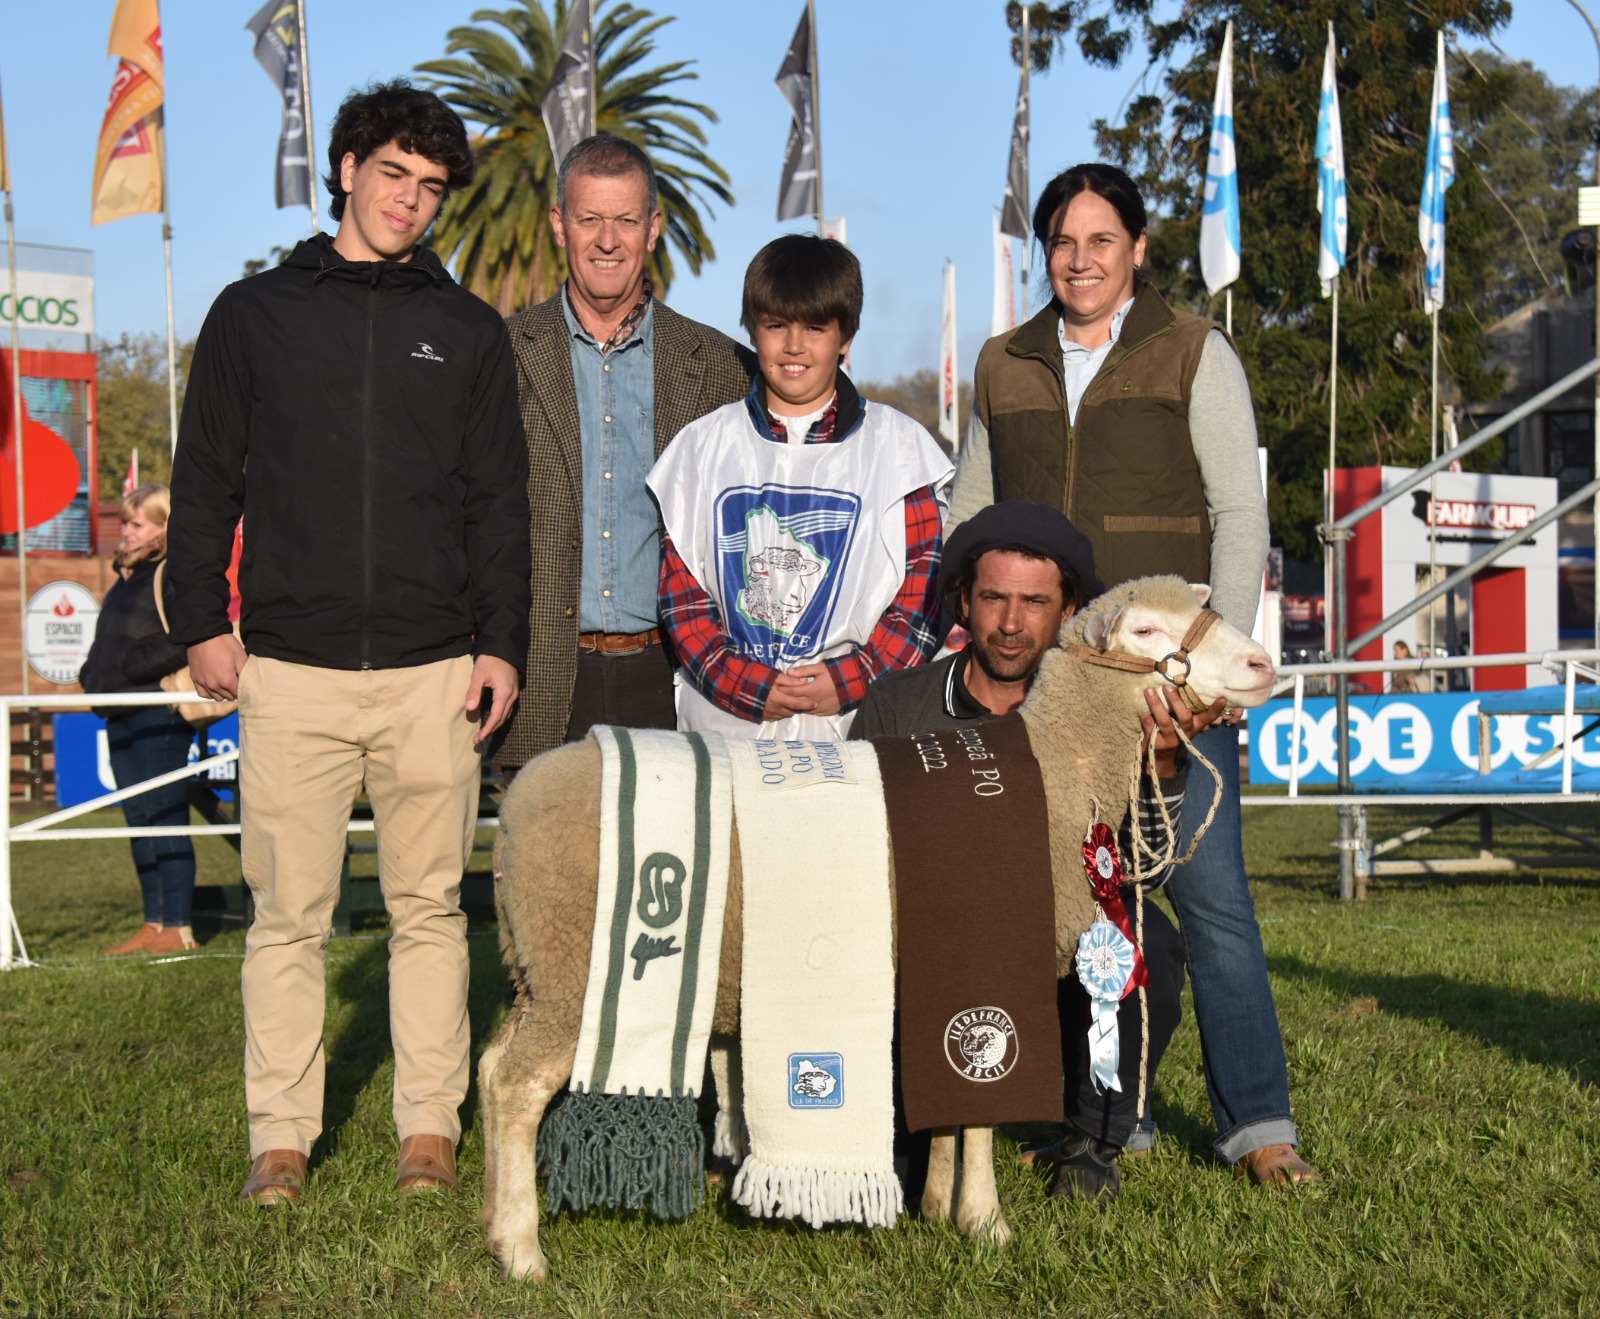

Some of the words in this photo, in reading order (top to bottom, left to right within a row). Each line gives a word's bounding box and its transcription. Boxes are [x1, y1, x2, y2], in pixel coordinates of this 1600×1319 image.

[1274, 716, 1416, 767] BSE
[790, 754, 814, 773] PO
[916, 741, 948, 773] 2022
[971, 767, 1004, 796] PO
[949, 1021, 965, 1040] ILE
[961, 1012, 978, 1025] DE
[979, 1010, 1014, 1037] FRANCE
